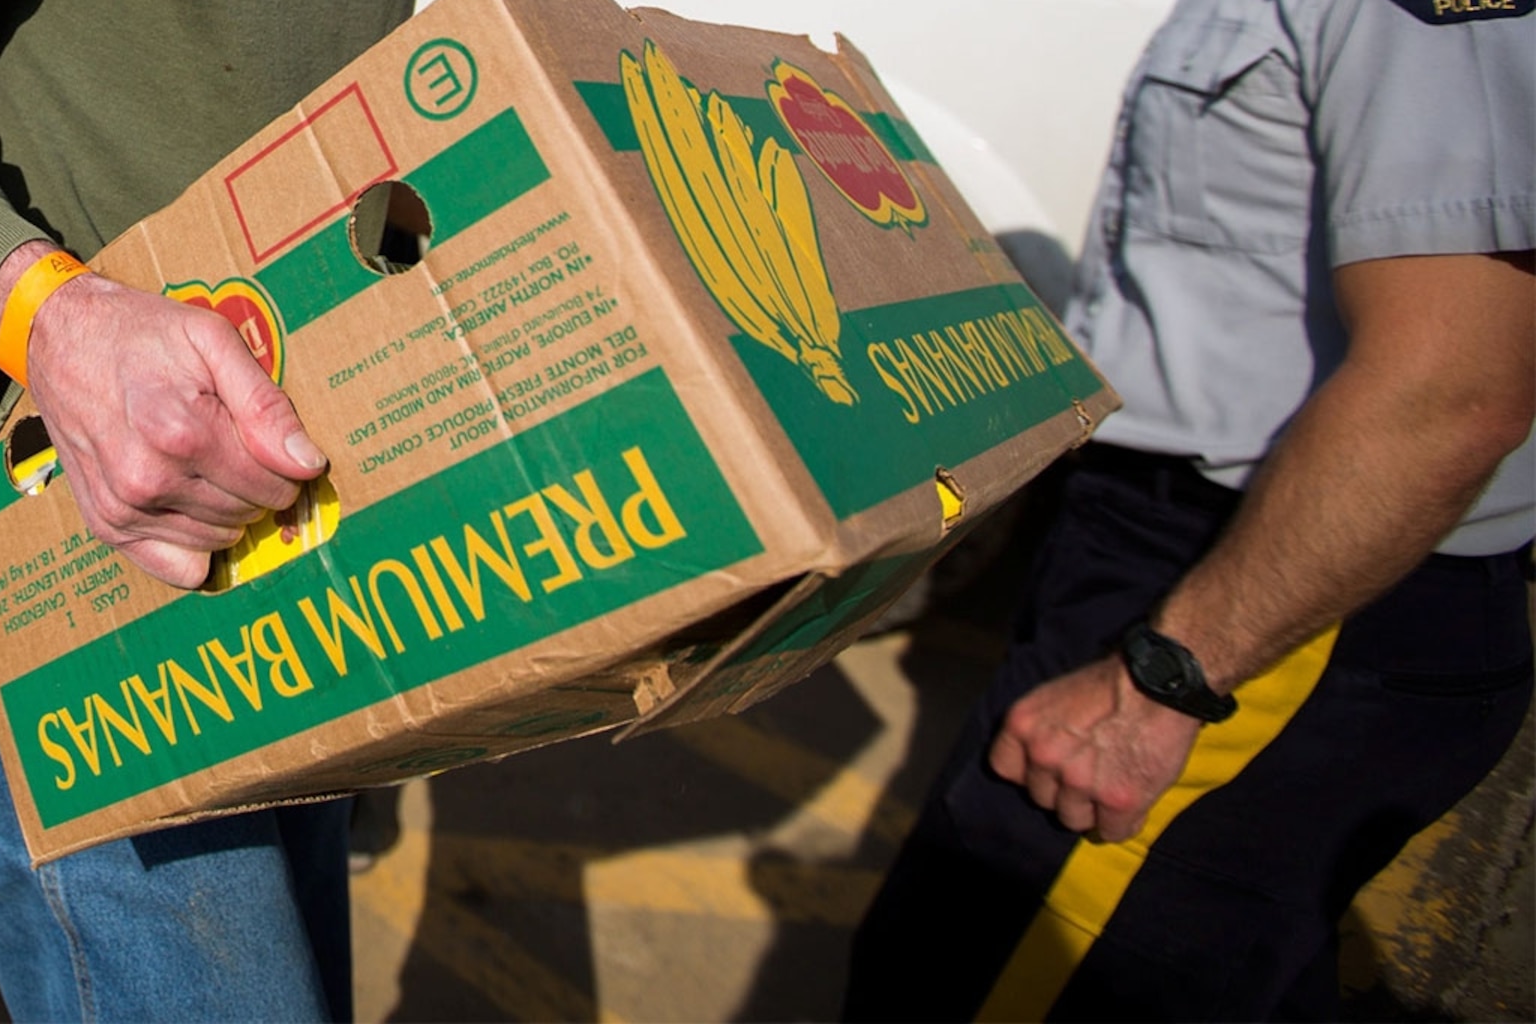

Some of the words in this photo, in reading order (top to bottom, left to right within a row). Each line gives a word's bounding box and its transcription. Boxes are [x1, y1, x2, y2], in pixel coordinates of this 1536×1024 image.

[527, 254, 554, 276] Box
[508, 267, 566, 307] NORTH
[583, 284, 603, 303] 74
[441, 297, 509, 344] AMERICA:
[446, 298, 478, 323] Coral
[521, 294, 585, 336] Boulevard
[389, 338, 406, 354] FL
[531, 308, 593, 349] EUROPE,
[602, 324, 639, 351] DEL
[327, 346, 391, 390] 33114-9222
[458, 350, 480, 370] MC
[481, 341, 532, 376] PACIFIC
[544, 342, 604, 382] MONTE
[611, 342, 649, 370] FOR
[866, 320, 1010, 424] BANANAS
[420, 362, 459, 390] 98000
[424, 380, 456, 405] AND
[454, 366, 482, 390] RIM
[494, 372, 544, 406] FRESH
[500, 360, 612, 424] INFORMATION
[375, 381, 421, 412] Monaco
[377, 396, 426, 430] MIDDLE
[346, 421, 378, 447] EAST:
[424, 397, 495, 442] PRODUCE
[447, 414, 501, 451] ABOUT
[358, 432, 424, 475] CONTACT:
[8, 563, 24, 583] kg
[59, 541, 116, 580] MINIMUM
[298, 446, 685, 678] PREMIUM
[11, 570, 59, 606] LENGTH:
[73, 561, 124, 598] VARIETY:
[3, 590, 67, 635] CAVENDISH
[90, 582, 131, 614] CLASS:
[37, 612, 311, 790] BANANAS
